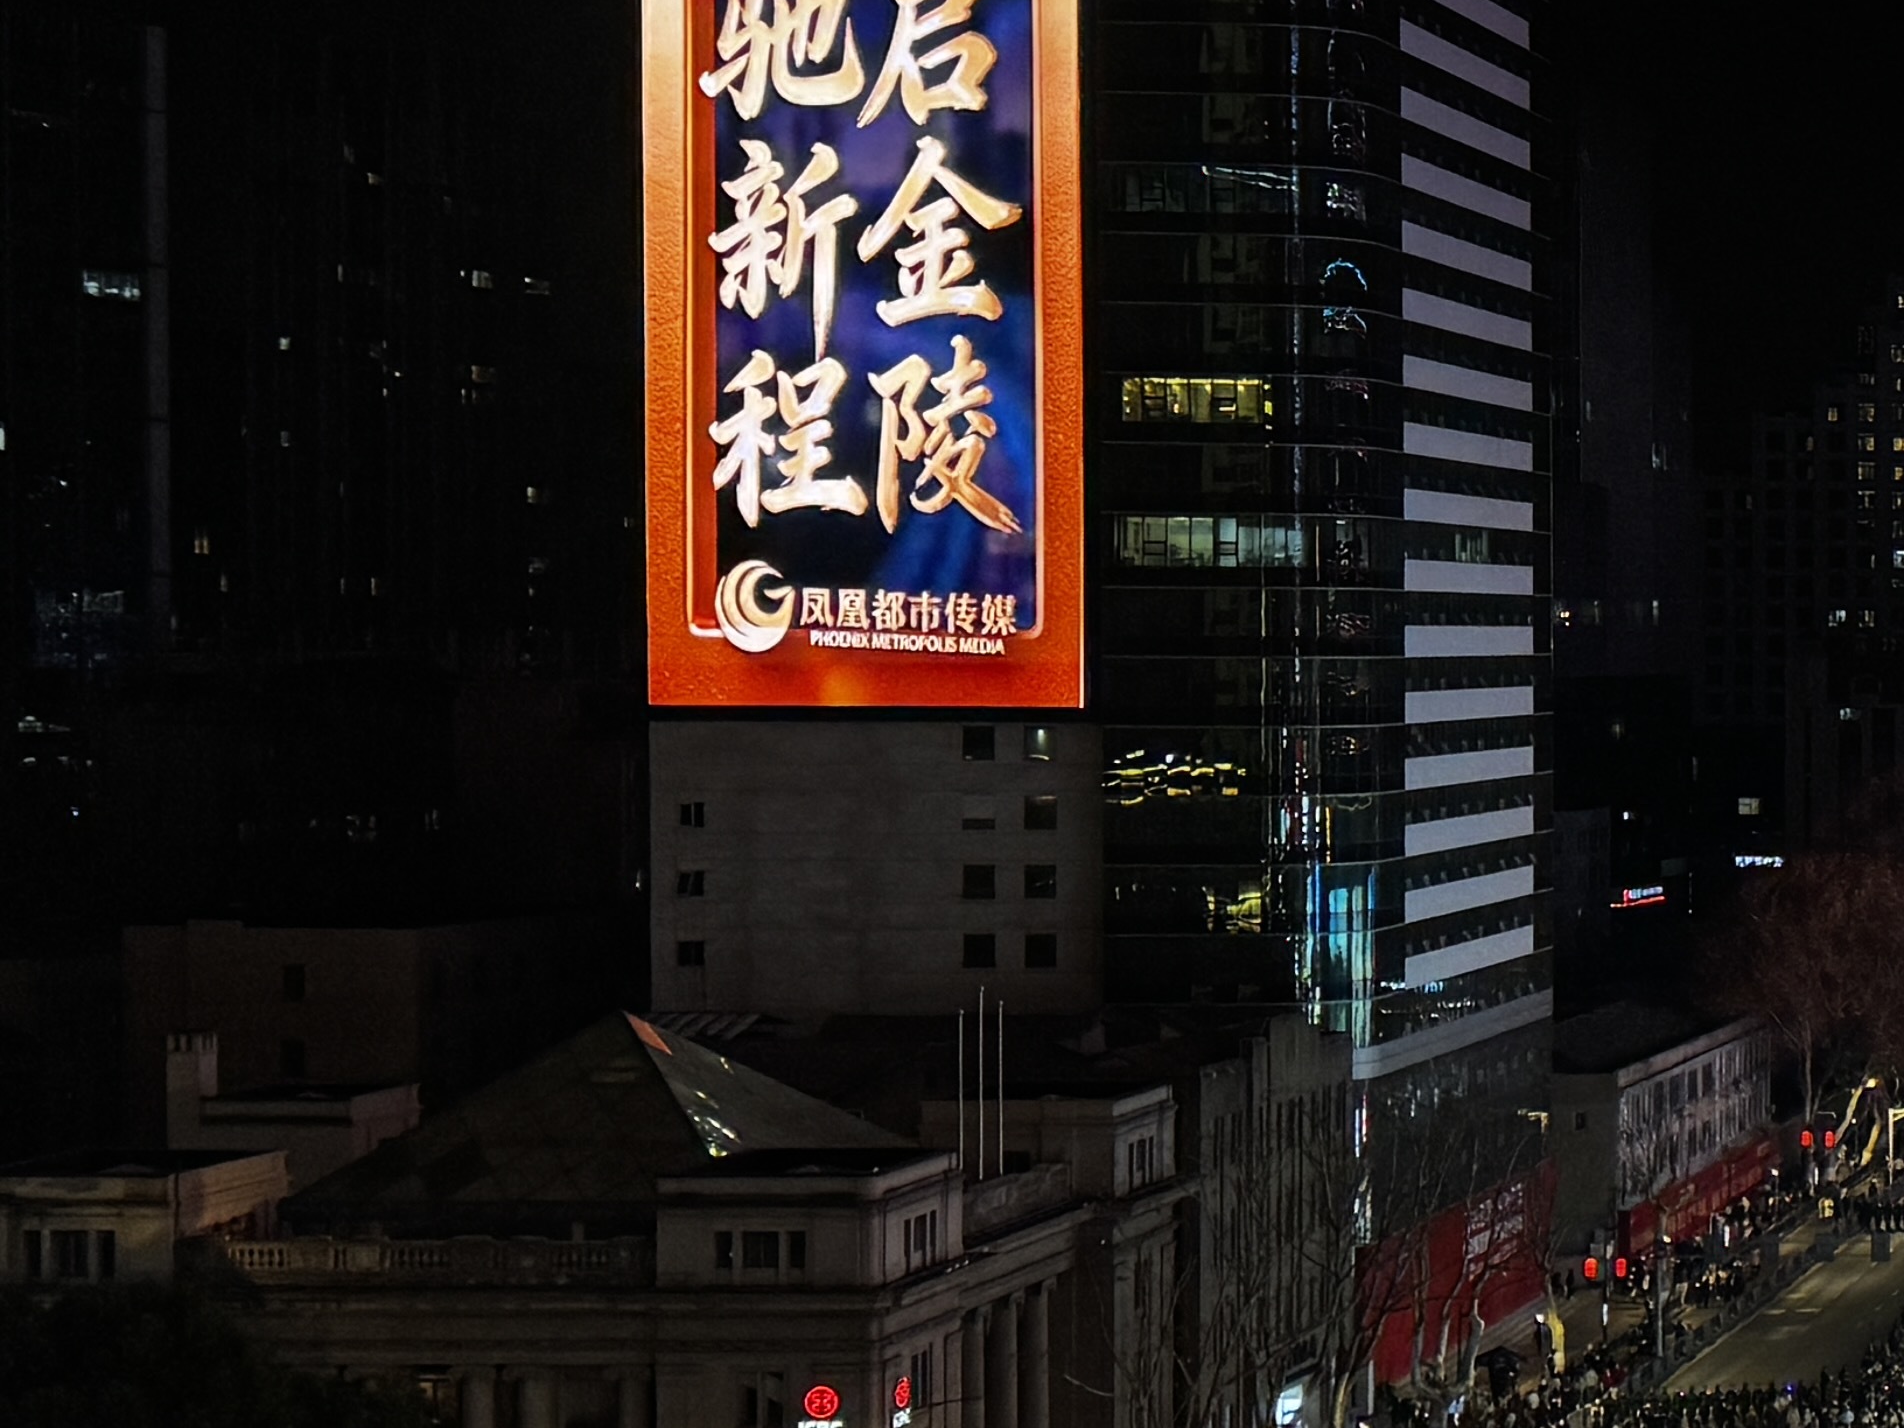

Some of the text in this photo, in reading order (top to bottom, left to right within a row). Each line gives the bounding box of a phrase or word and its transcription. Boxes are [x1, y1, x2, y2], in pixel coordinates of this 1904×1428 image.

[800, 587, 1018, 636] 凤凰都市传媒
[810, 630, 1006, 656] PHOENIX METROPOLIS MEDIA
